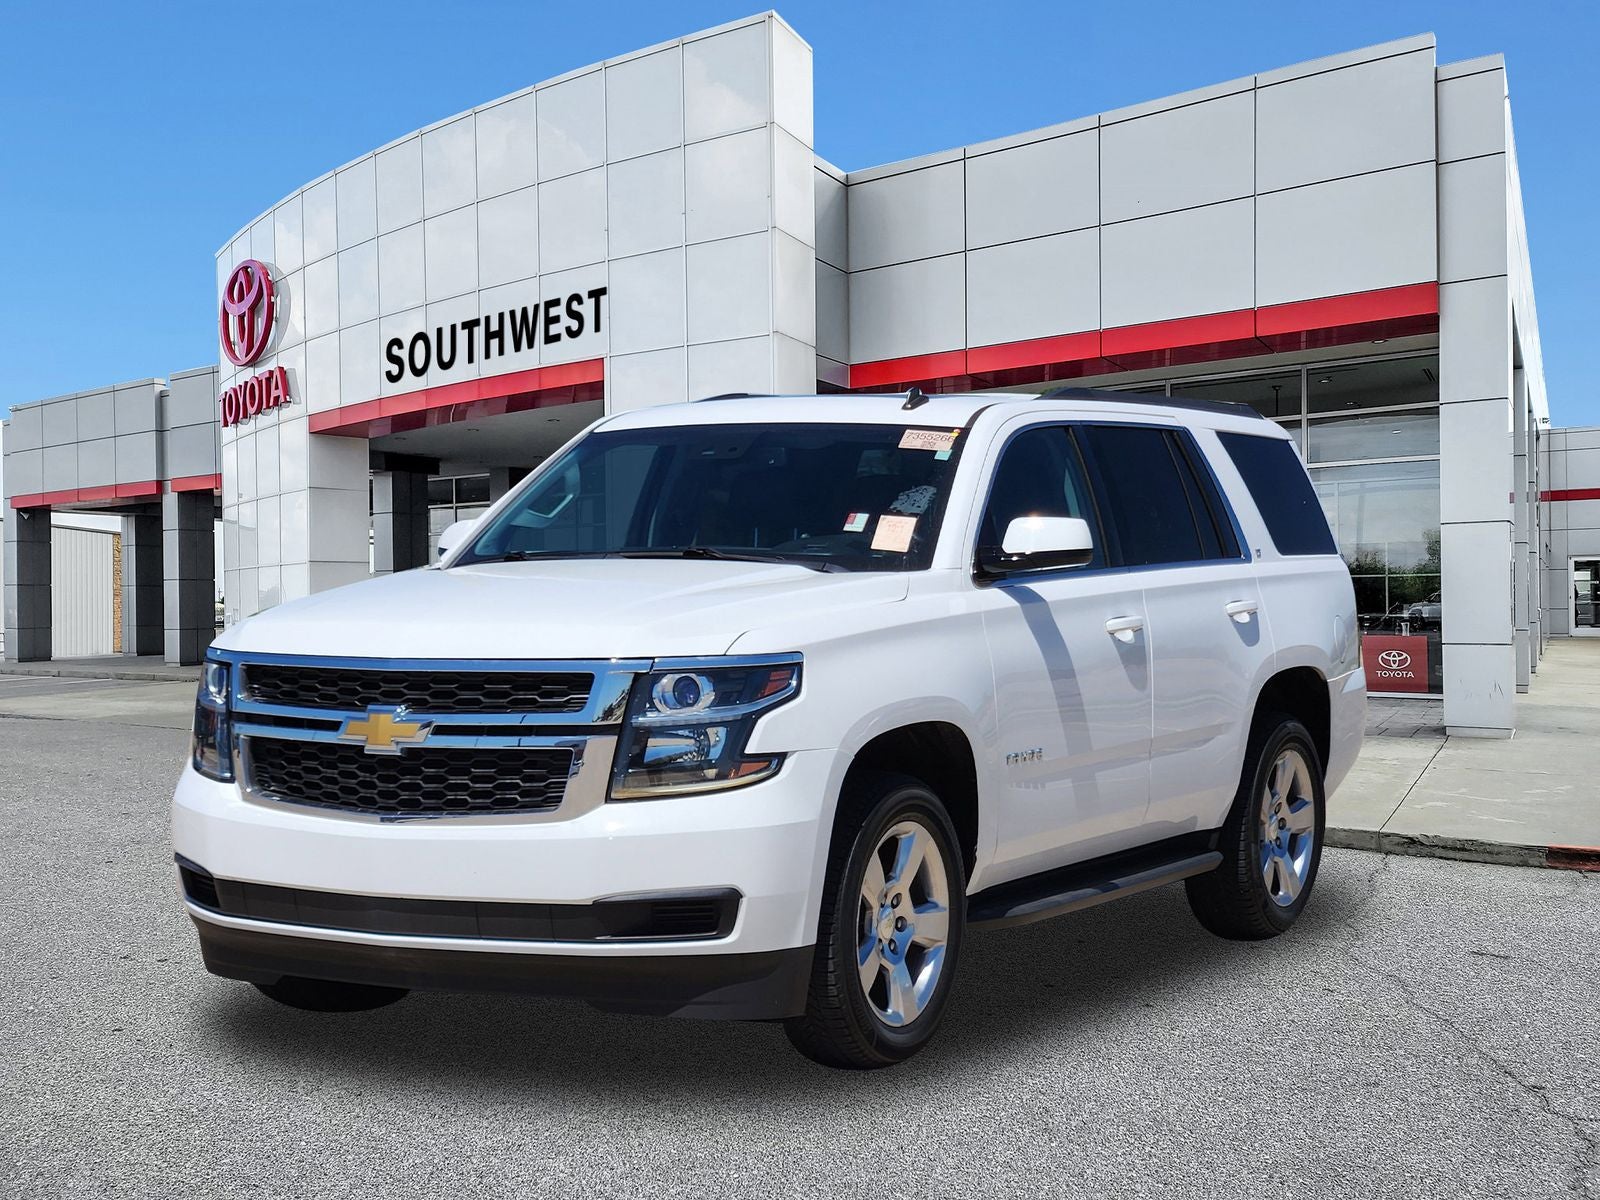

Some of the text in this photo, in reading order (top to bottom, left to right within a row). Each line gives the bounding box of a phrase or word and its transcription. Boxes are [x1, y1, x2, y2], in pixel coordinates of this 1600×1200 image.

[385, 286, 608, 384] SOUTHWEST
[218, 366, 292, 428] TOYOTA
[1375, 670, 1415, 678] TOYOTA
